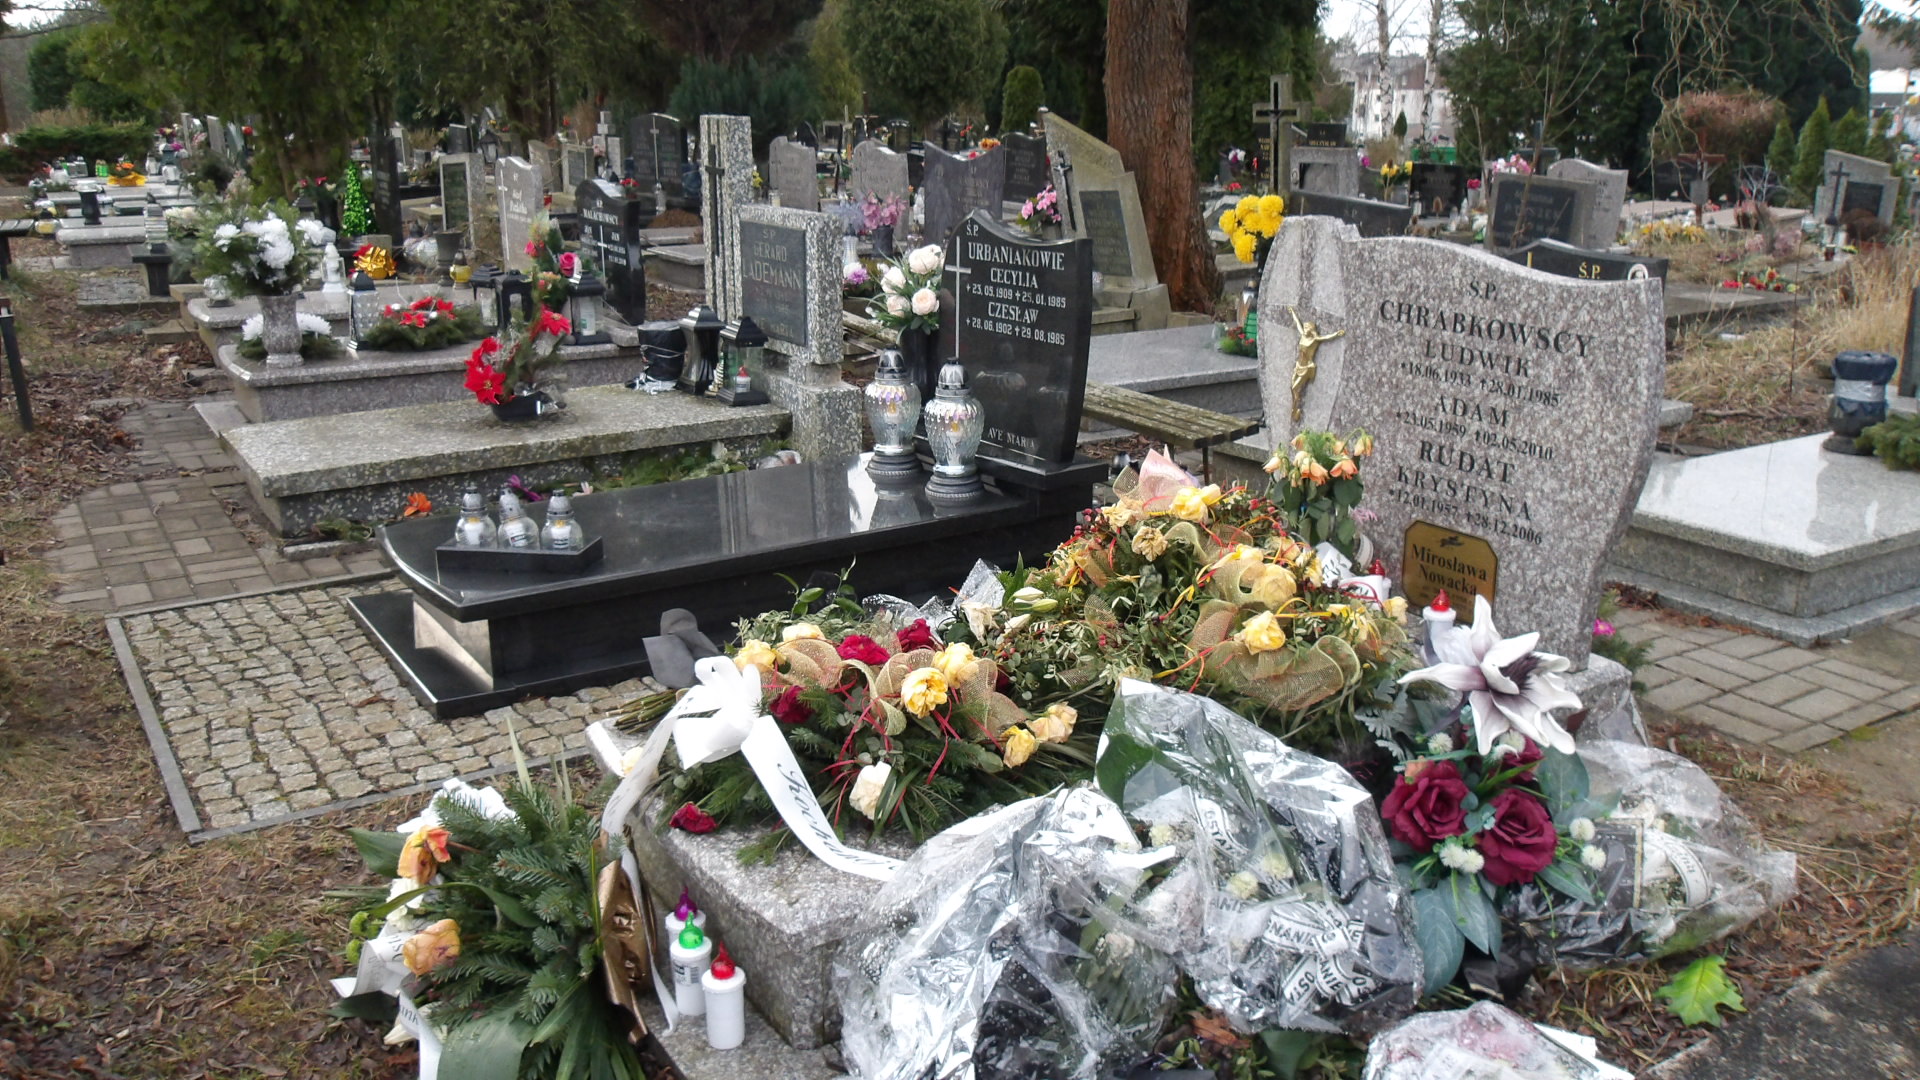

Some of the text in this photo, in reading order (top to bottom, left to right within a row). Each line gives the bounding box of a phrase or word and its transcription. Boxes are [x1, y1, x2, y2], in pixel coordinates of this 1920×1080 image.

[967, 241, 1065, 271] URBANIAKOWIE
[990, 267, 1039, 289] CECYLIA
[988, 301, 1039, 324] CZESŁAW
[1380, 299, 1594, 357] CHRABKOWSCY
[1425, 340, 1530, 378] LUDWIK
[1434, 394, 1508, 428] ADAM
[988, 427, 1036, 449] AVE MARIA
[1419, 440, 1516, 484] RUDAT
[1398, 465, 1532, 522] KRYSTYNA
[1411, 543, 1487, 582] Mirosława
[1418, 564, 1478, 597] Nowacka
